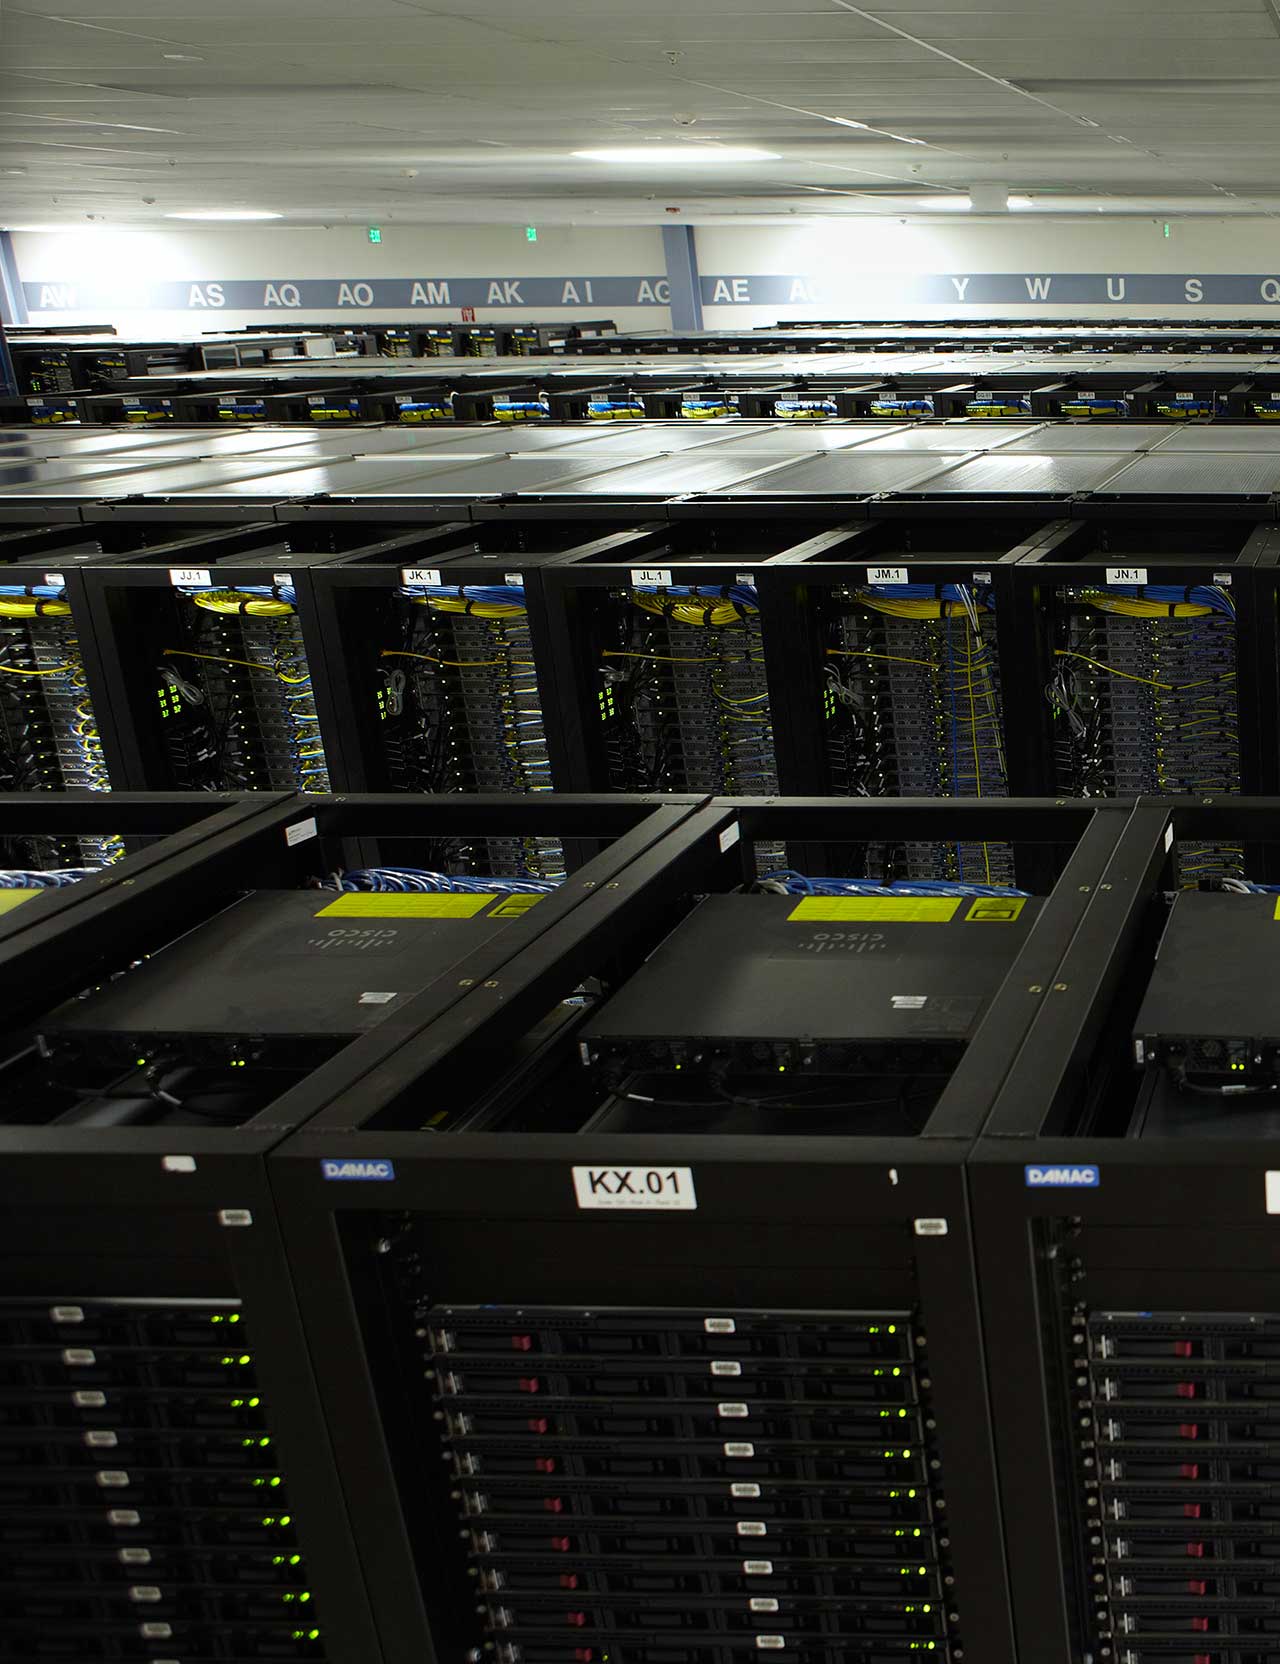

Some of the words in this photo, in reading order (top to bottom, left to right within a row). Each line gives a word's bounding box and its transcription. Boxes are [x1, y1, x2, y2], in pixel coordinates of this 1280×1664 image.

[188, 284, 226, 307] AS
[264, 284, 302, 307] AQ
[338, 283, 374, 306] AO
[411, 282, 451, 305] AM
[488, 281, 524, 304] AK
[713, 279, 751, 303] AE
[951, 278, 970, 301] Y
[1025, 278, 1052, 300] W
[1106, 278, 1125, 300] U
[1184, 279, 1203, 302] S
[180, 571, 201, 581] JJ.1
[408, 570, 432, 581] JK.1
[640, 571, 662, 581] JL.1
[874, 569, 900, 579] JM.1
[1114, 569, 1139, 579] JN.1
[324, 1163, 389, 1177] DAMAC
[1028, 1168, 1095, 1183] DAMAC
[588, 1170, 679, 1194] KX.01
